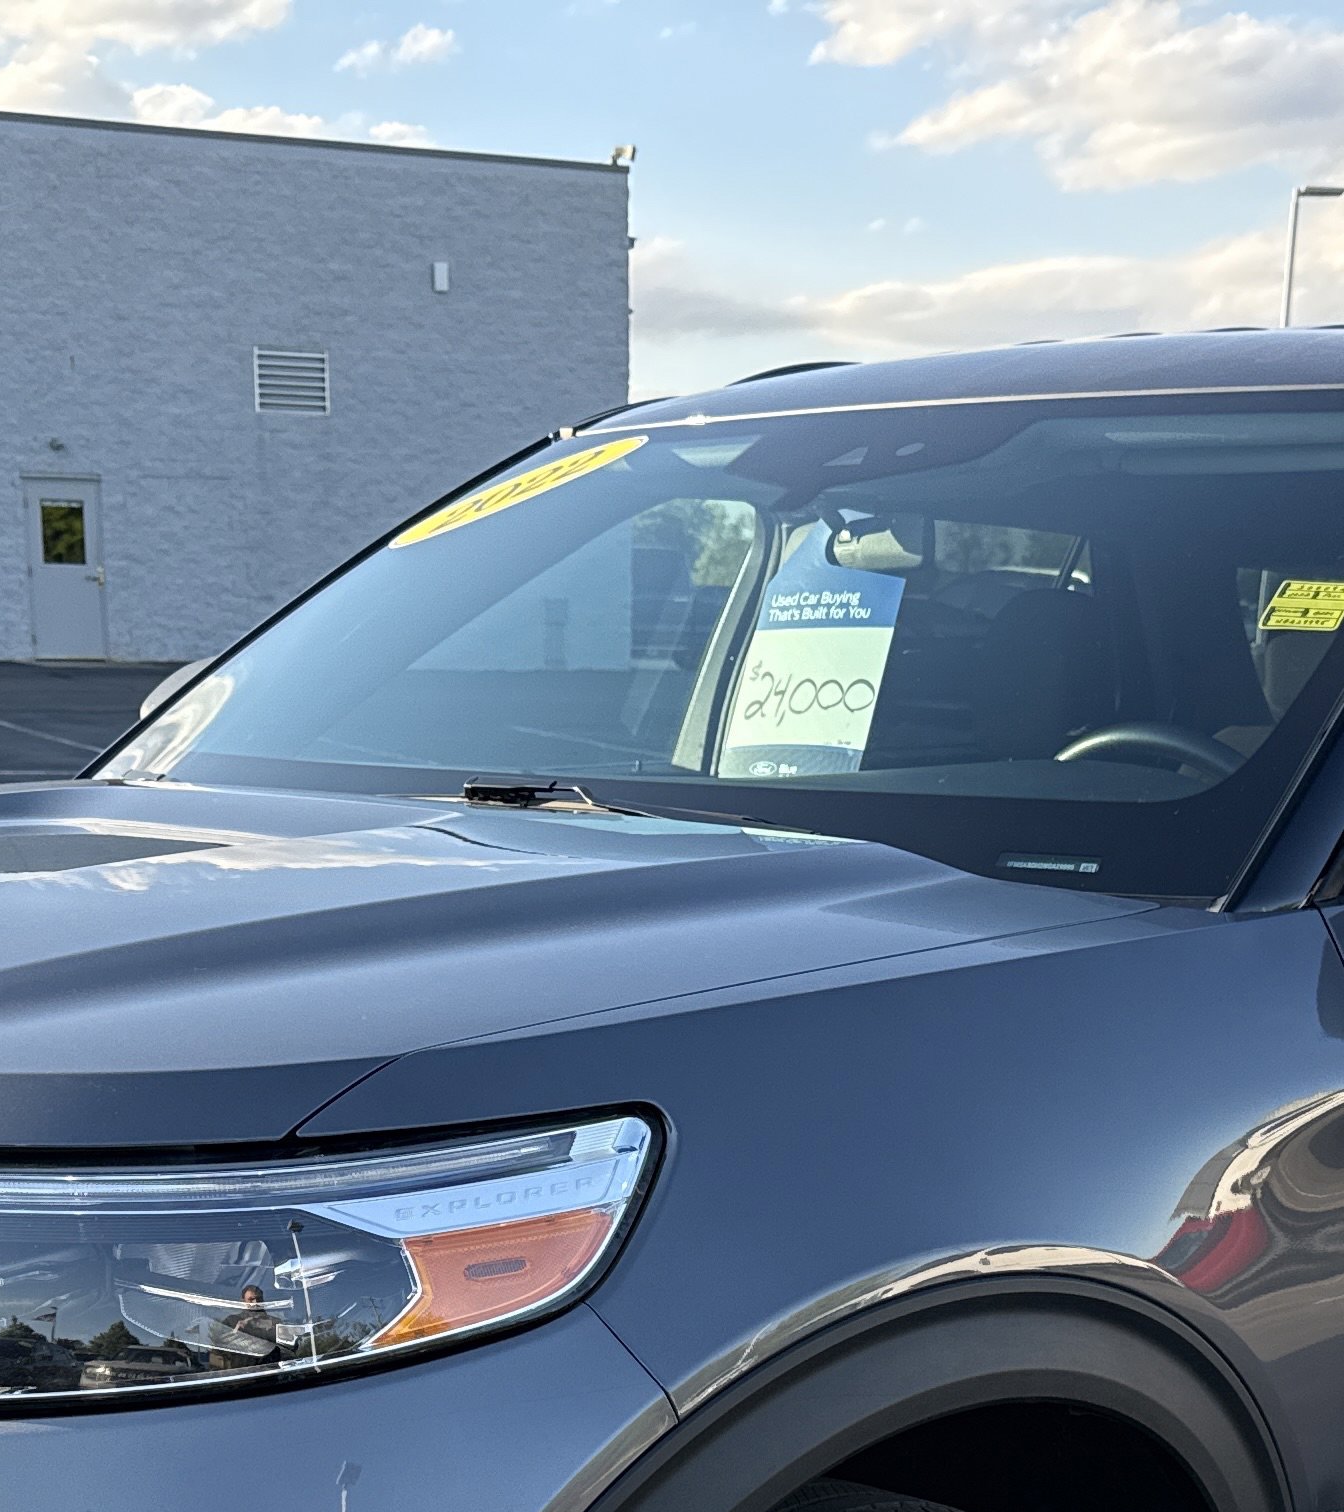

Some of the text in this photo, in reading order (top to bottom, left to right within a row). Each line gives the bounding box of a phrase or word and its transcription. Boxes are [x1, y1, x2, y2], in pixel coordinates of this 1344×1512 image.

[428, 449, 606, 534] 2022
[768, 606, 871, 622] That's Built for You
[771, 590, 861, 607] Used Car Buying
[744, 660, 876, 728] $24,000
[394, 1176, 593, 1222] EXPLORER
